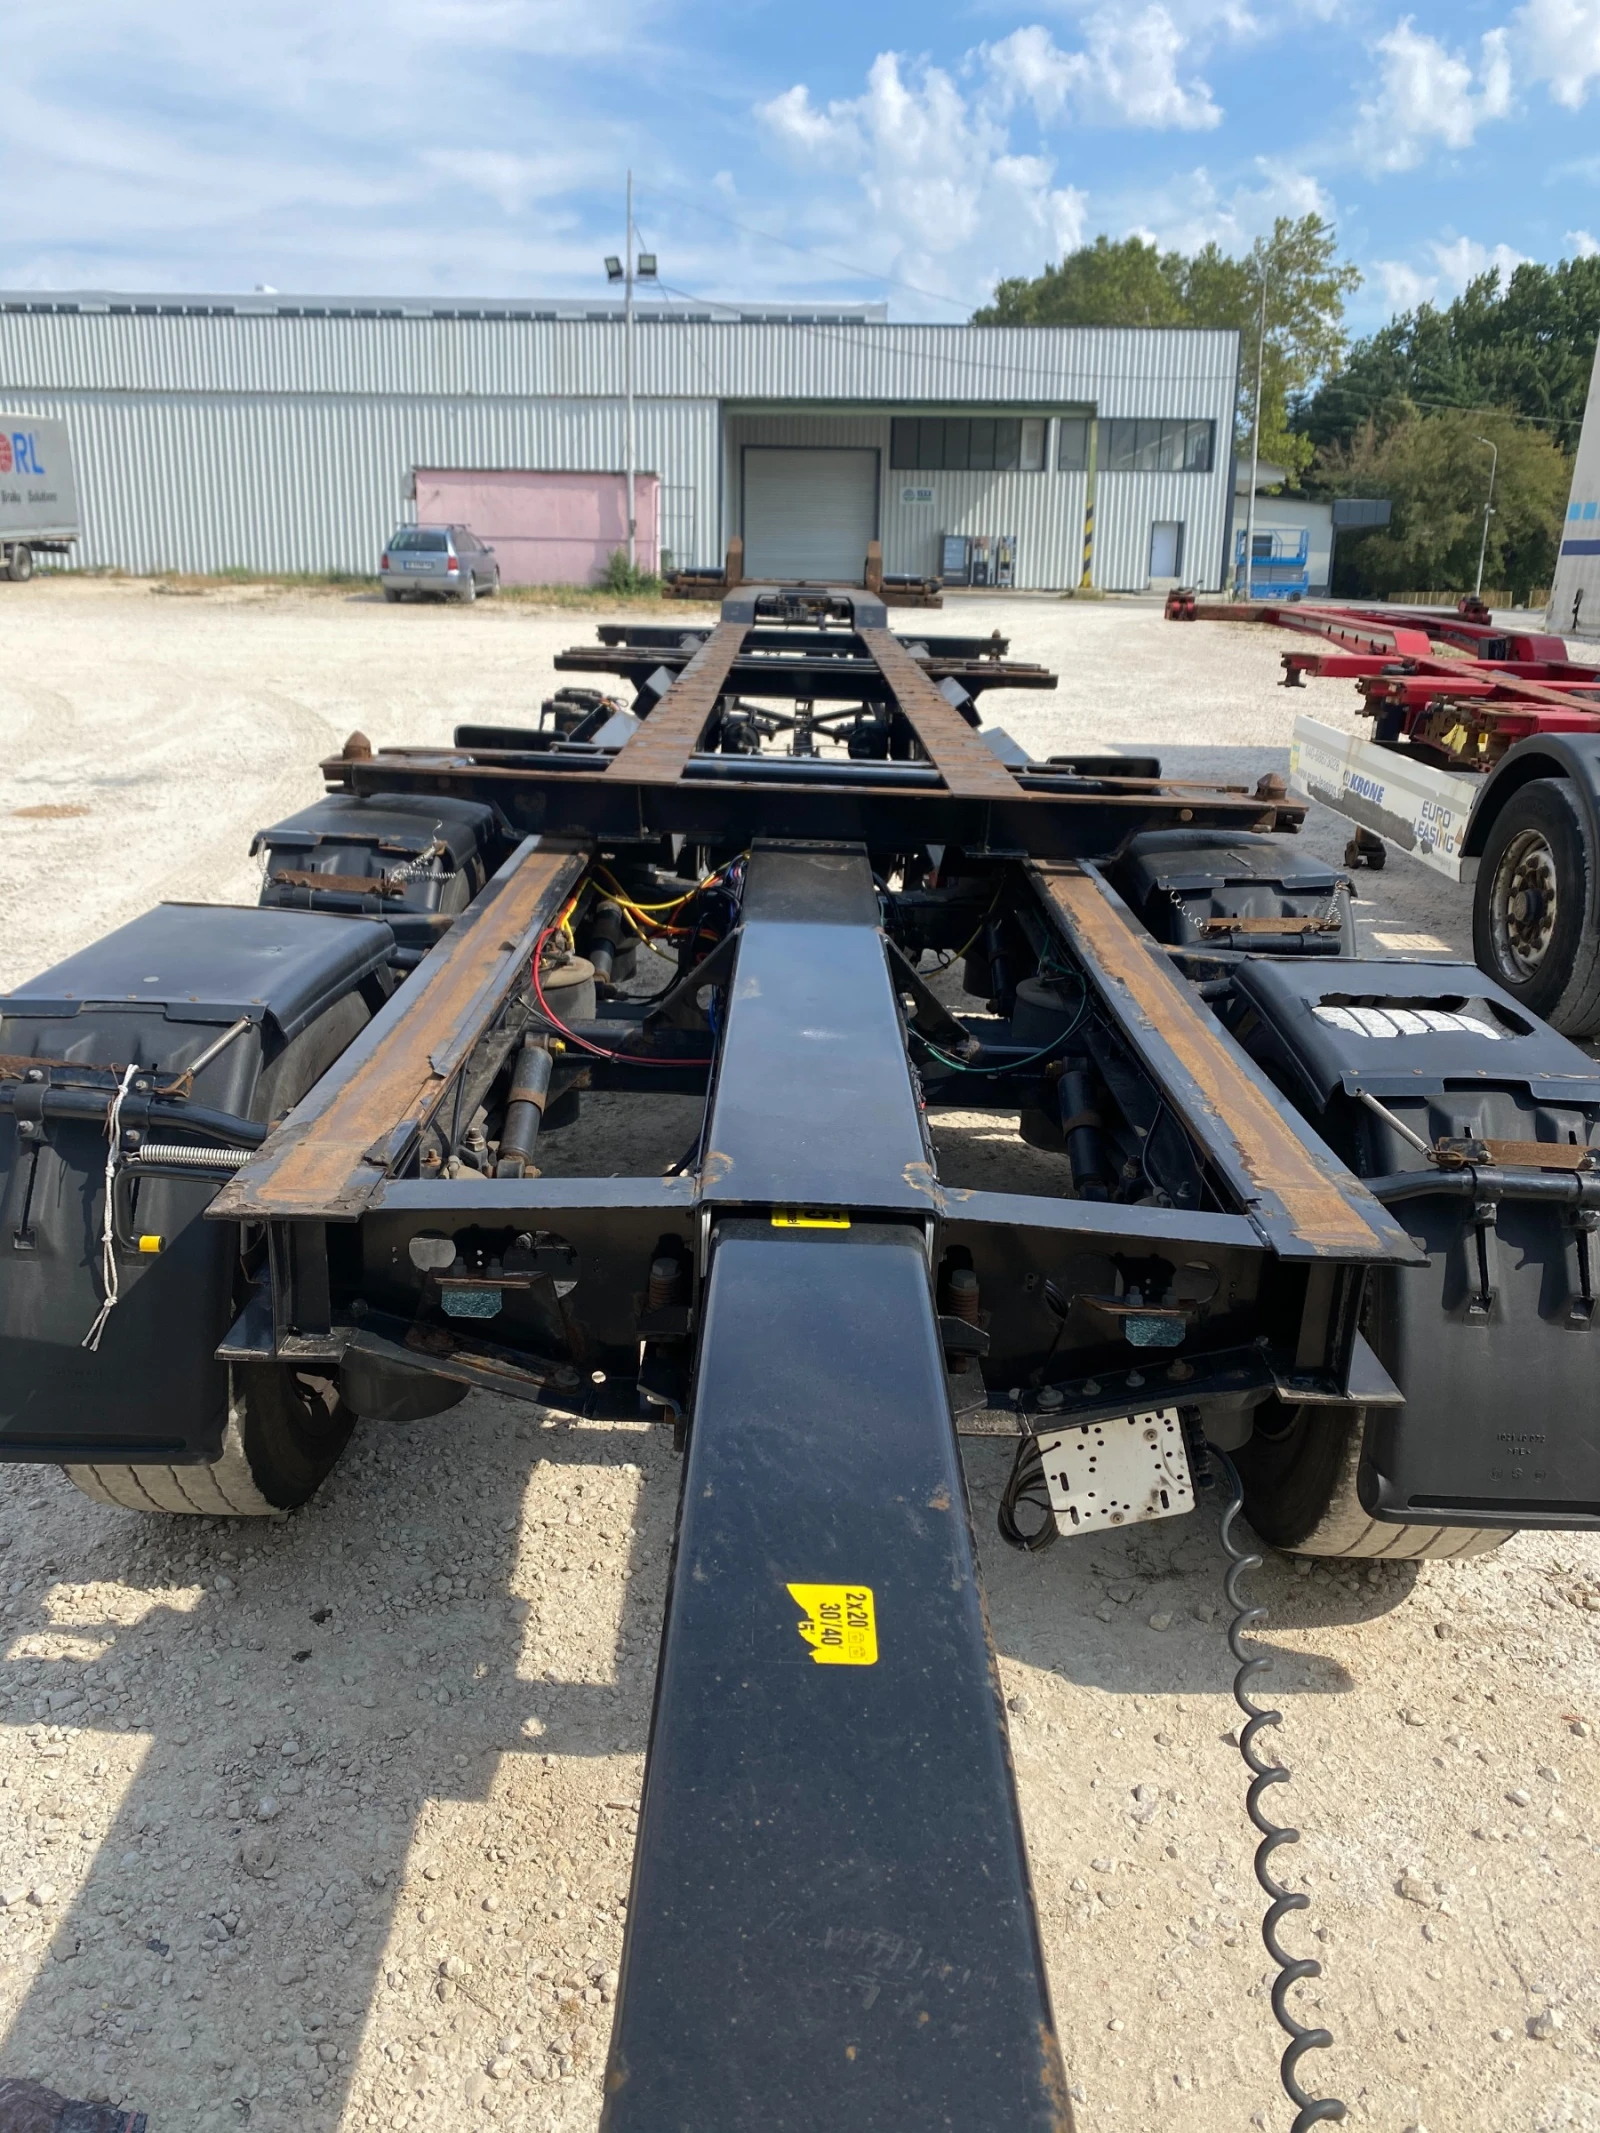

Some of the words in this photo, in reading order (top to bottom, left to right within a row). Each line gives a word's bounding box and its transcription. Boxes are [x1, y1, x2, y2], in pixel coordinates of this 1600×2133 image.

[1349, 773, 1385, 803] KRONE
[1421, 800, 1452, 829] EURO
[1413, 817, 1455, 854] LEASING
